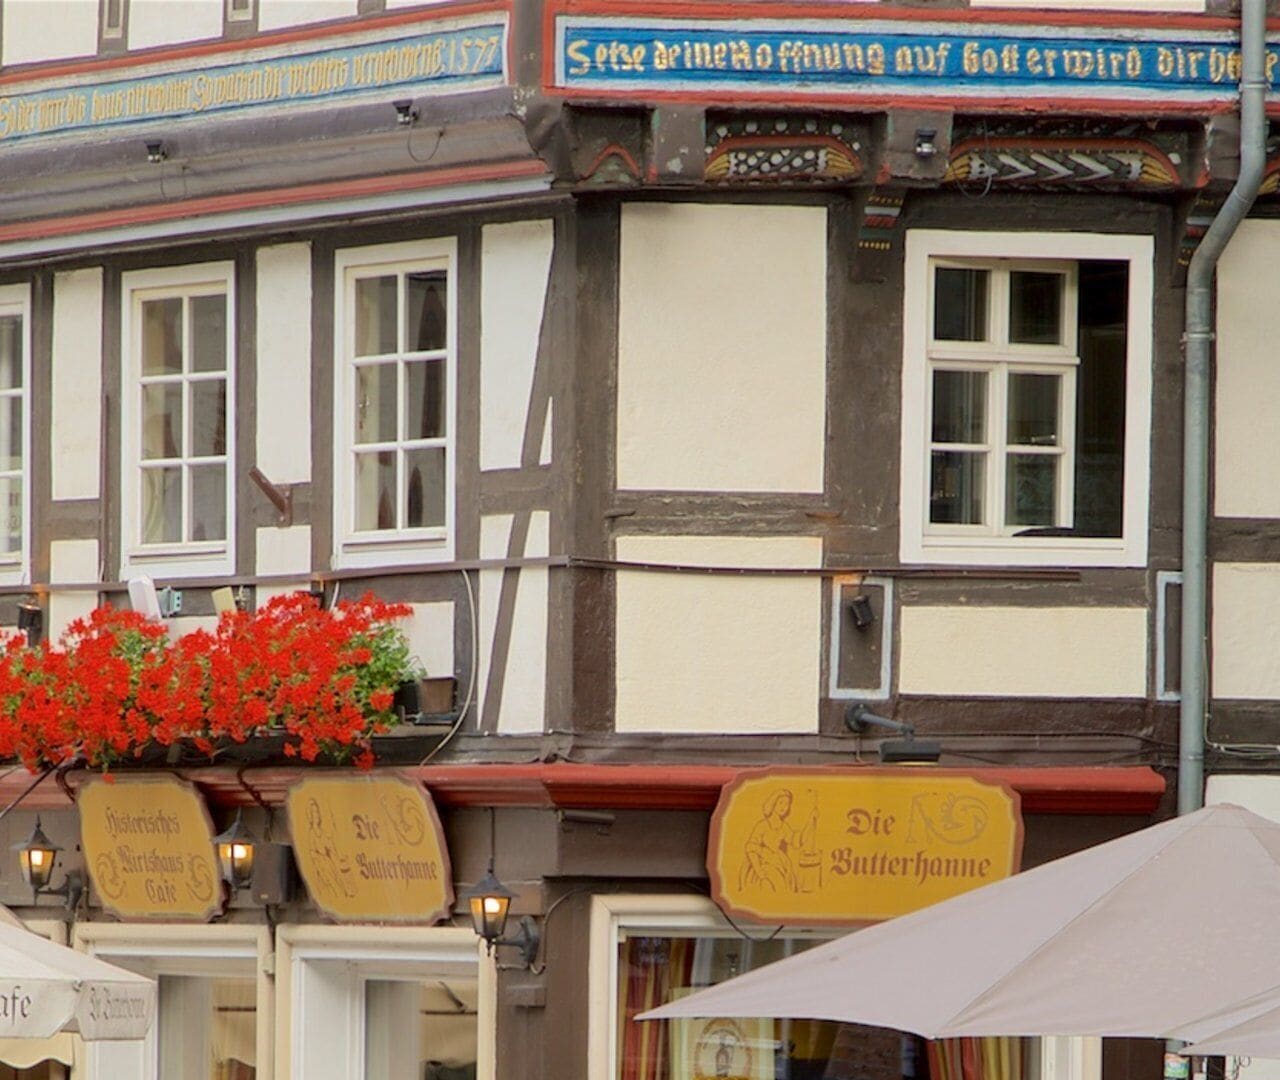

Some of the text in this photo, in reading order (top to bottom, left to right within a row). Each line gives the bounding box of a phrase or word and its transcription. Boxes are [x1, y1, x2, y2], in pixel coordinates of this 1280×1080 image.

[448, 36, 500, 73] 1577
[894, 42, 952, 77] auf
[351, 813, 381, 842] Die
[845, 807, 896, 837] Die
[354, 852, 439, 891] Butterhanne
[830, 848, 992, 888] Butterhanne
